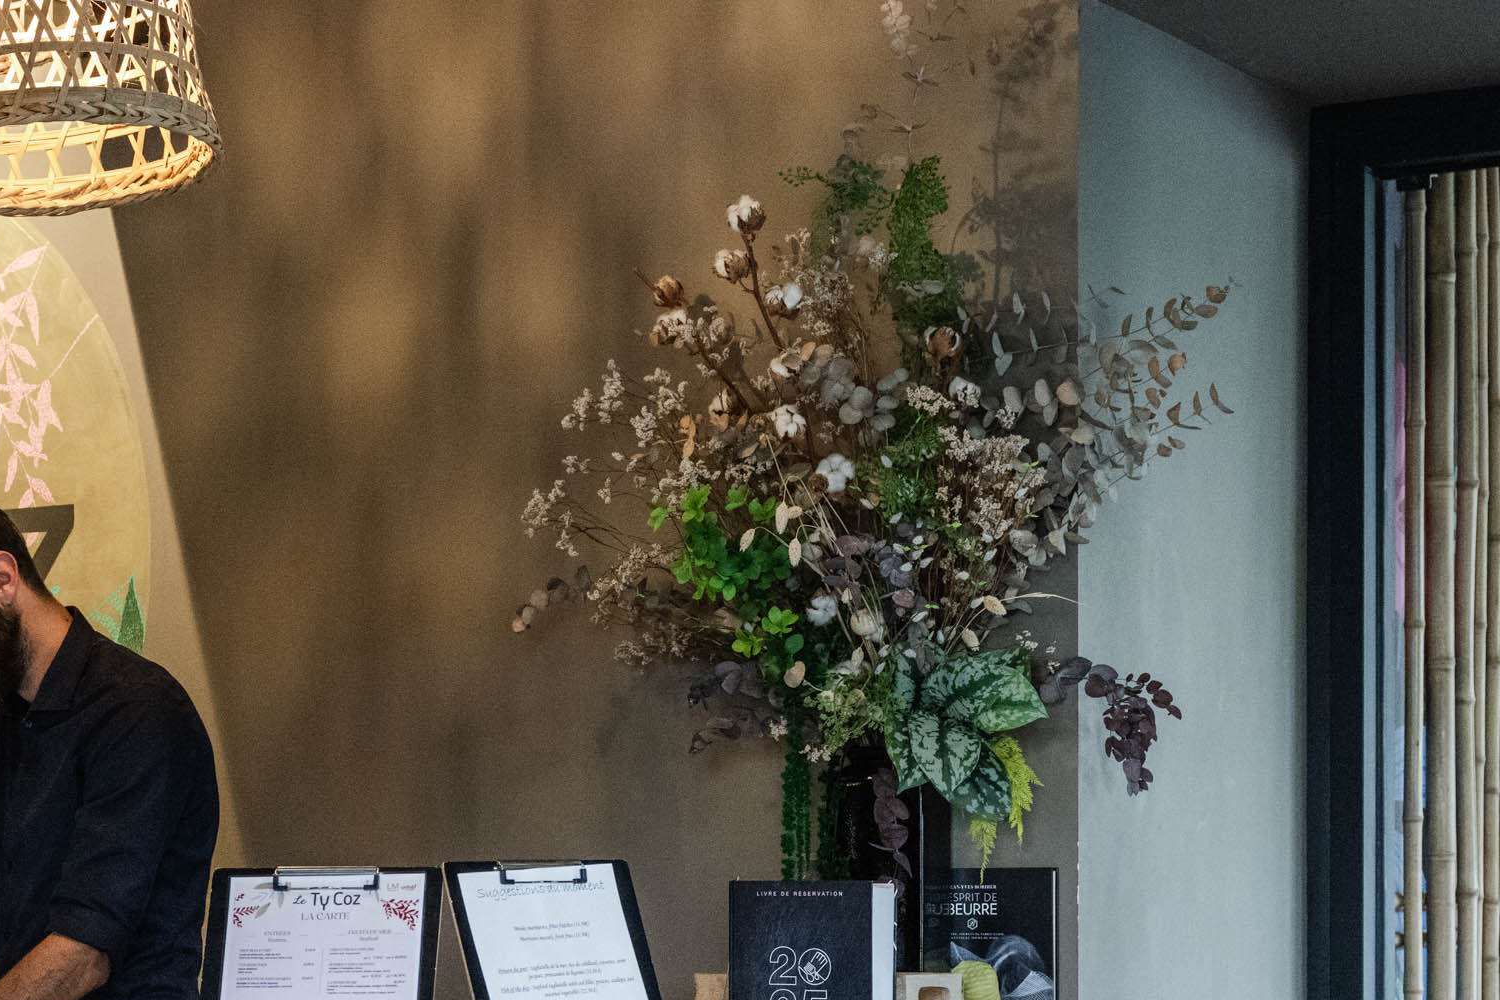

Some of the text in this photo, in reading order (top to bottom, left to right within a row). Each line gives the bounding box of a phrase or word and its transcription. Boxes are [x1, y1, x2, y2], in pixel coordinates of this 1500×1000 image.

[476, 885, 546, 901] Suggestions
[983, 892, 998, 902] DE
[292, 891, 361, 911] Le Ty Coz
[316, 911, 350, 921] CARTE
[949, 902, 998, 916] BEURRE
